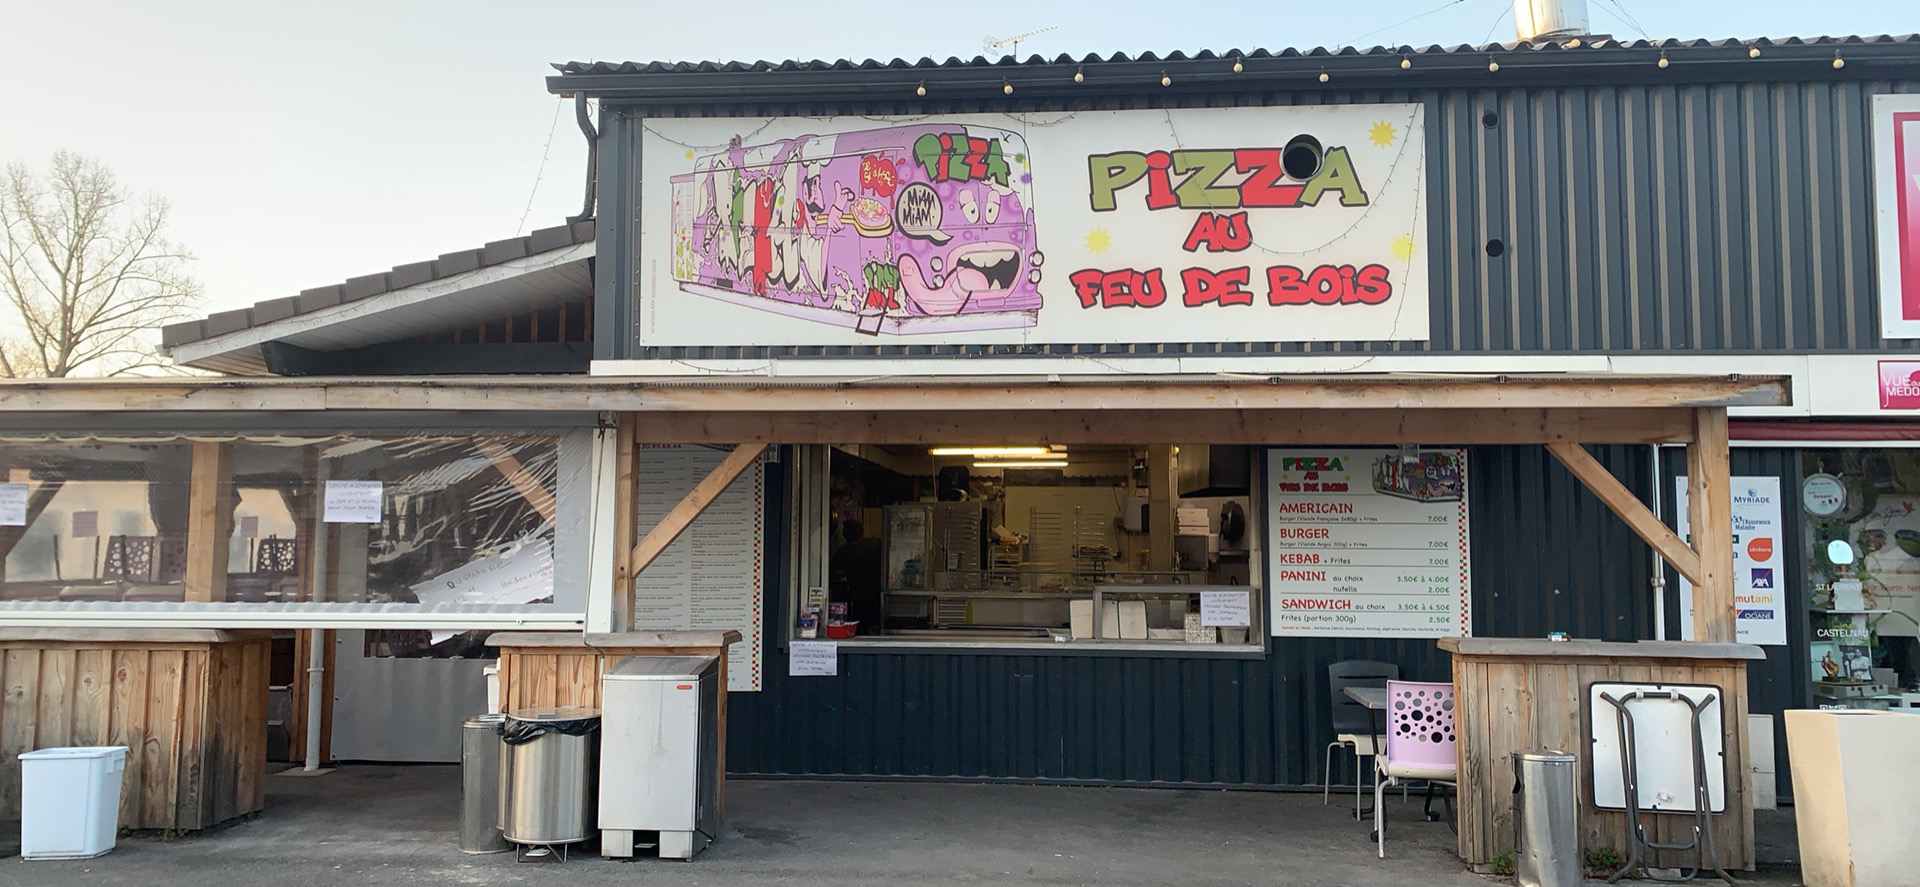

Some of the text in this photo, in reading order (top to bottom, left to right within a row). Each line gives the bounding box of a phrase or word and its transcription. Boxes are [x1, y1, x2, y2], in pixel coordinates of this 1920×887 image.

[1182, 211, 1253, 252] AU
[1069, 267, 1167, 309] FEU
[1180, 266, 1254, 307] DE
[1882, 375, 1911, 387] VUE
[1282, 457, 1344, 471] PIZZA
[1733, 496, 1770, 504] MYRIADE
[1279, 502, 1353, 514] AMERICAIN
[1280, 528, 1329, 539] BURGER
[1280, 553, 1320, 564] KEBAB
[1280, 570, 1326, 581] PANINI
[1344, 574, 1363, 582] choix
[1751, 577, 1769, 587] AXA
[1815, 583, 1825, 592] ST
[1333, 585, 1357, 593] nutella
[1281, 598, 1351, 610] SANDWICH
[1735, 594, 1773, 603] mutami
[1303, 614, 1333, 623] (portion
[1816, 628, 1869, 638] CASTELNAU
